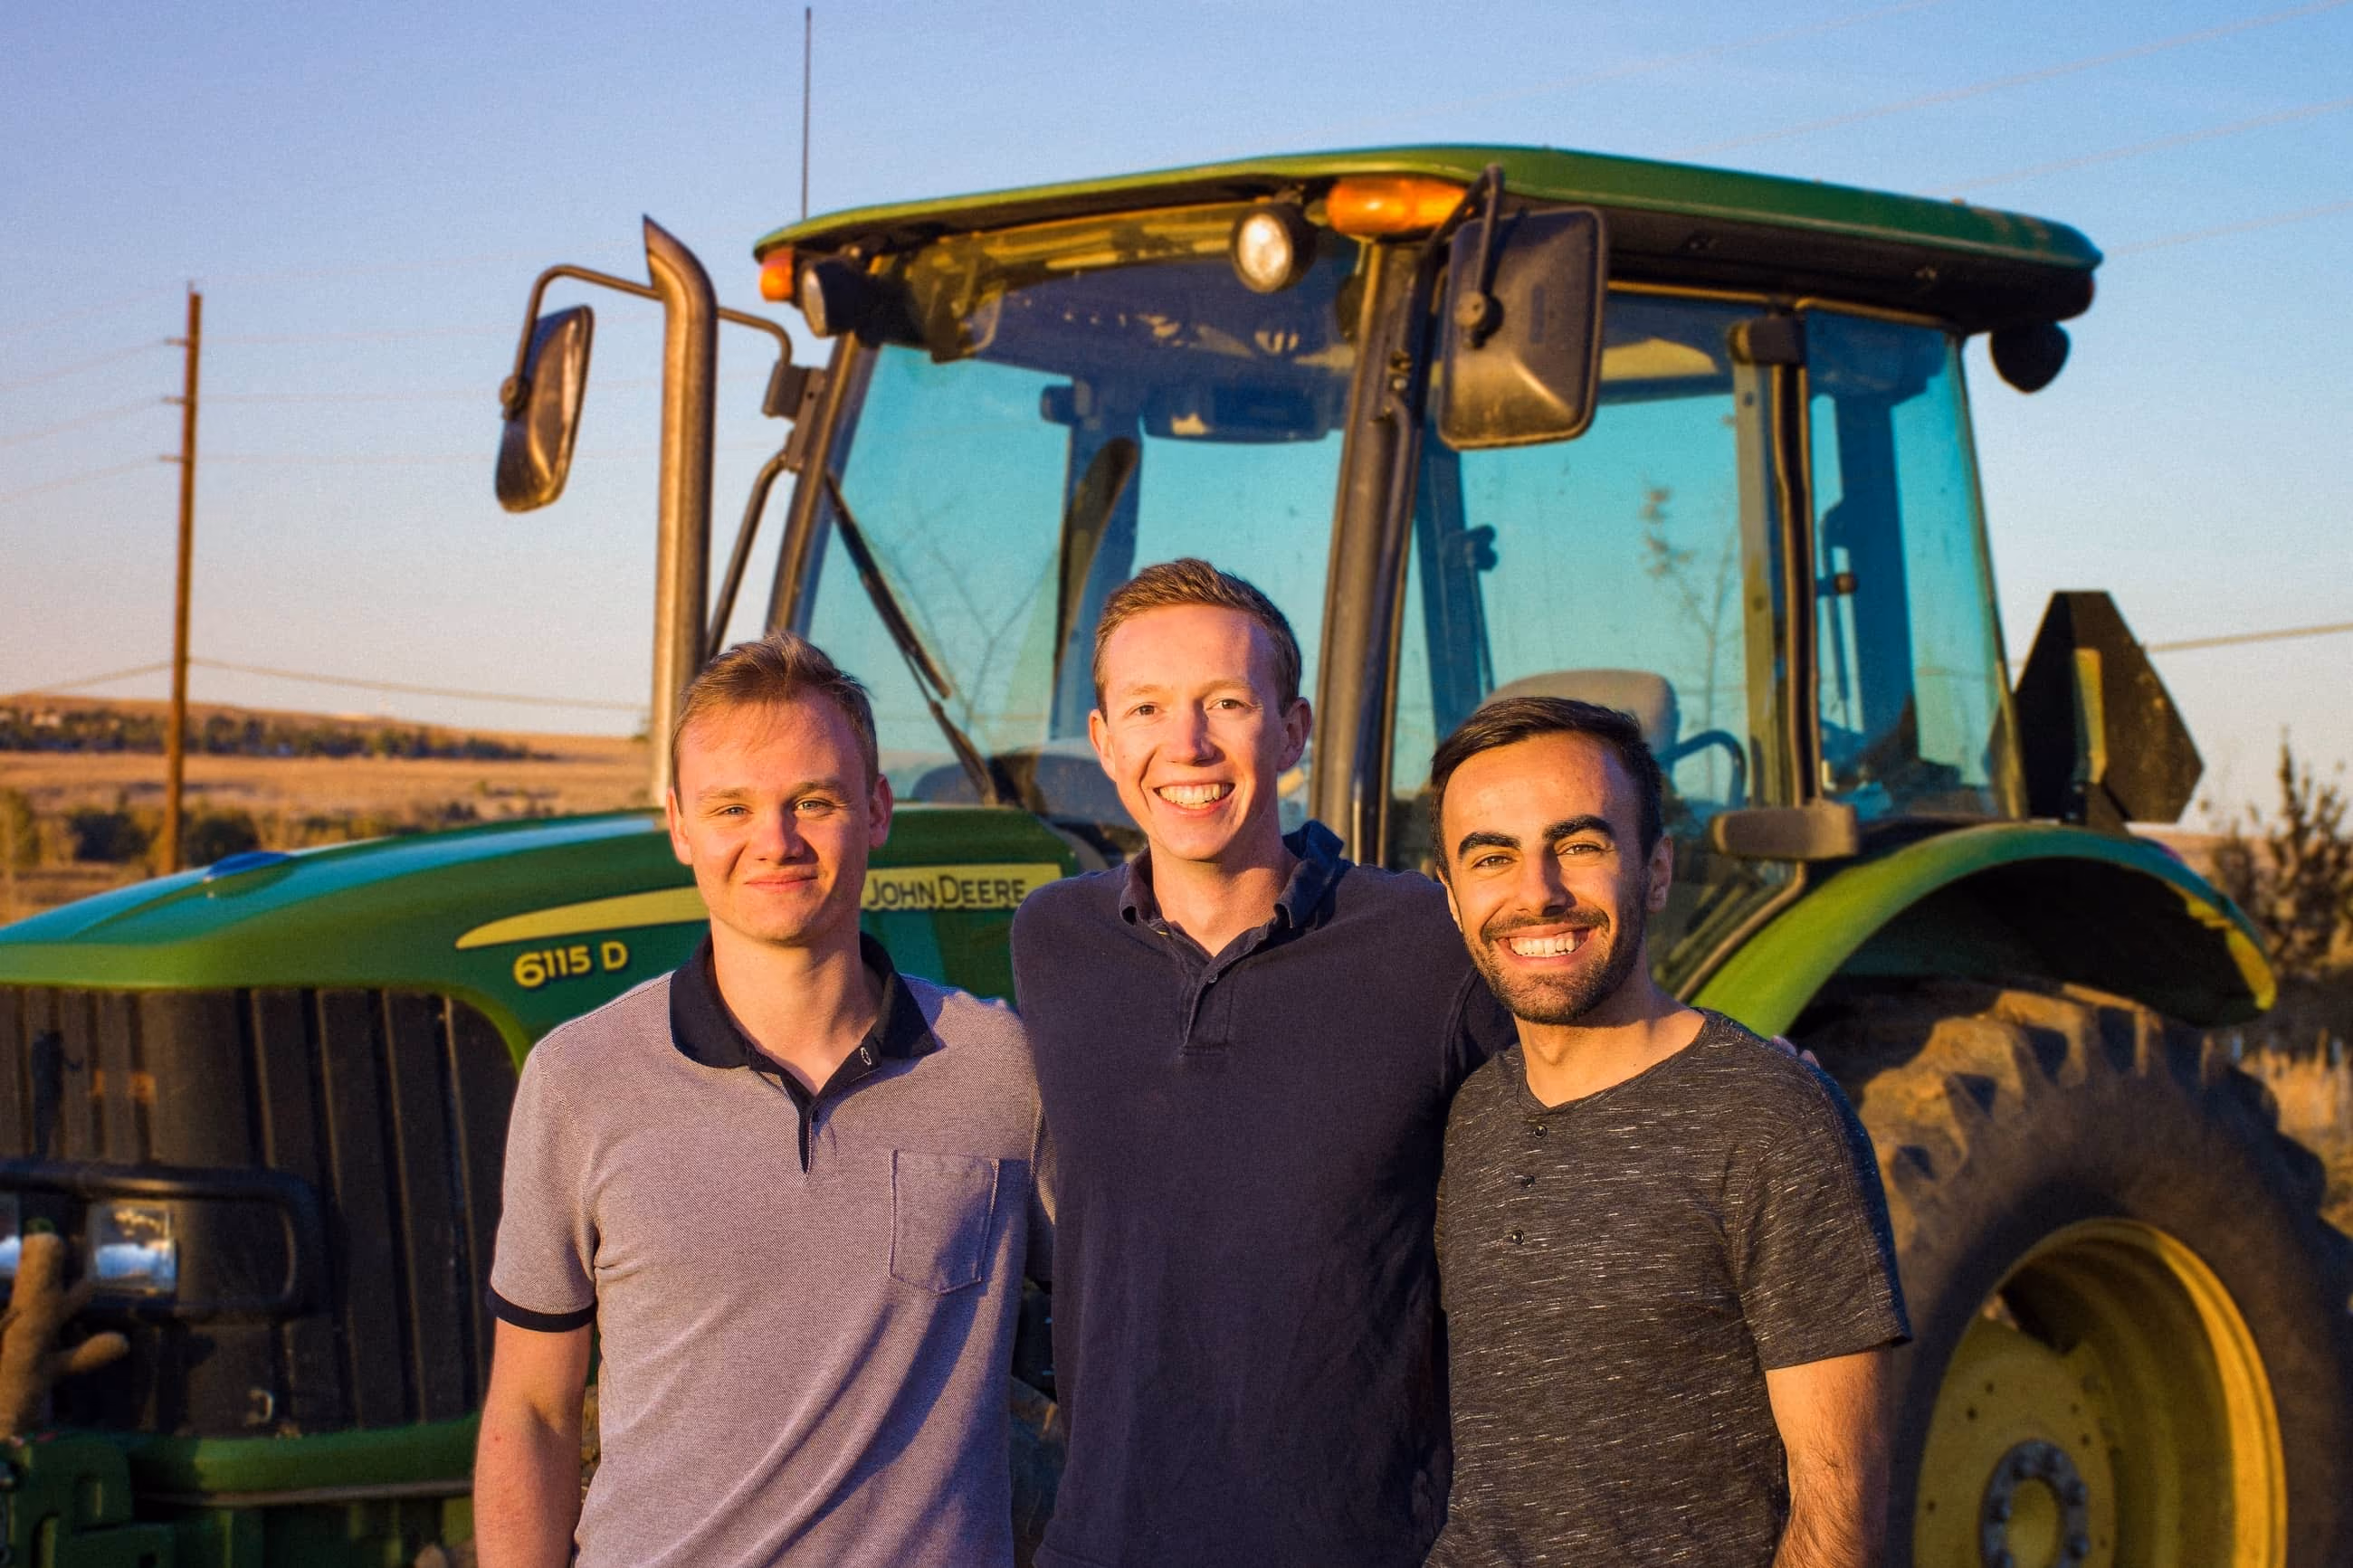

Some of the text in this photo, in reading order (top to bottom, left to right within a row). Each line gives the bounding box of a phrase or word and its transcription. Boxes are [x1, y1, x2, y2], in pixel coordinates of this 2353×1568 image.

[868, 875, 1025, 906] JOHN DEERE
[513, 940, 629, 989] 6115 D
